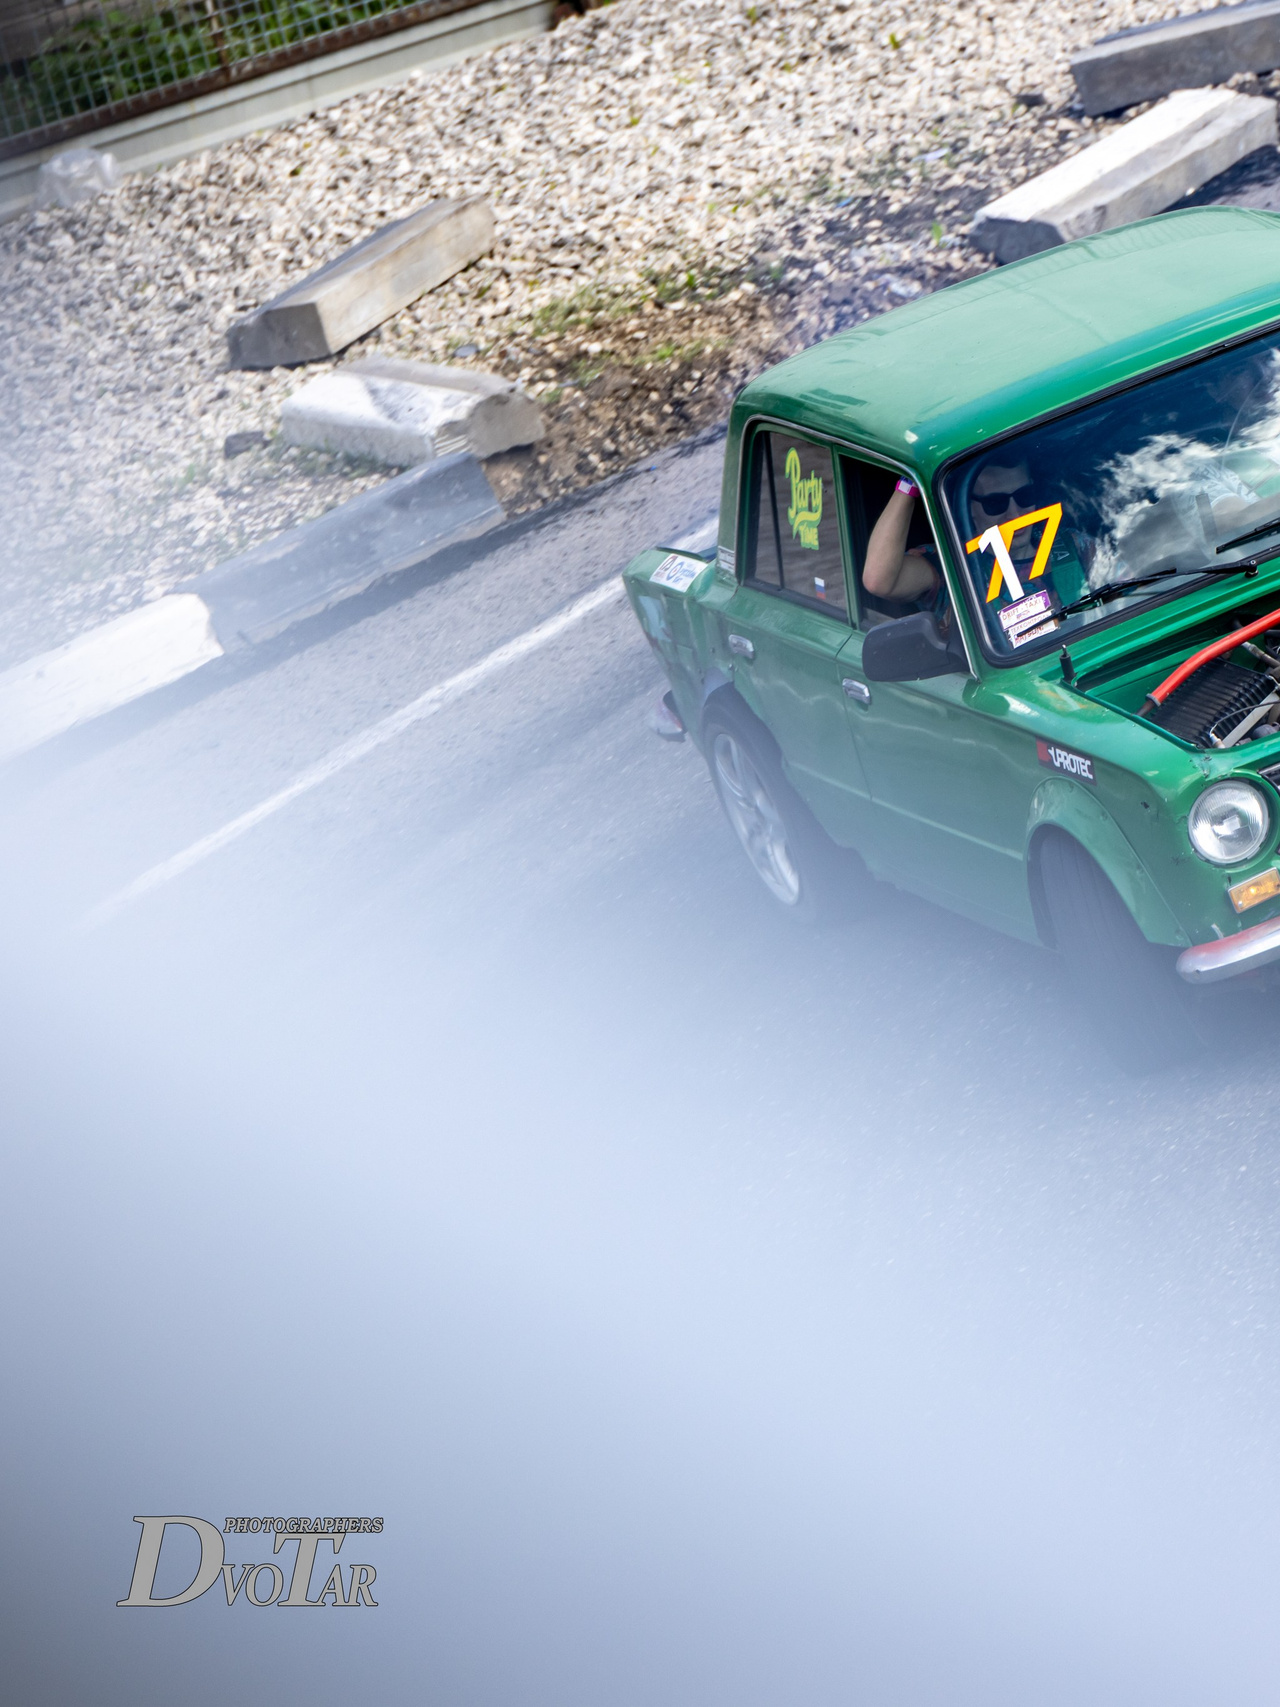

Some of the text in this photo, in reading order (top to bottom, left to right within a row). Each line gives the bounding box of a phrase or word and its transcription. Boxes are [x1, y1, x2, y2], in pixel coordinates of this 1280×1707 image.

[785, 447, 822, 540] Party
[1002, 607, 1019, 620] DRIFT
[1025, 599, 1041, 608] TAXI
